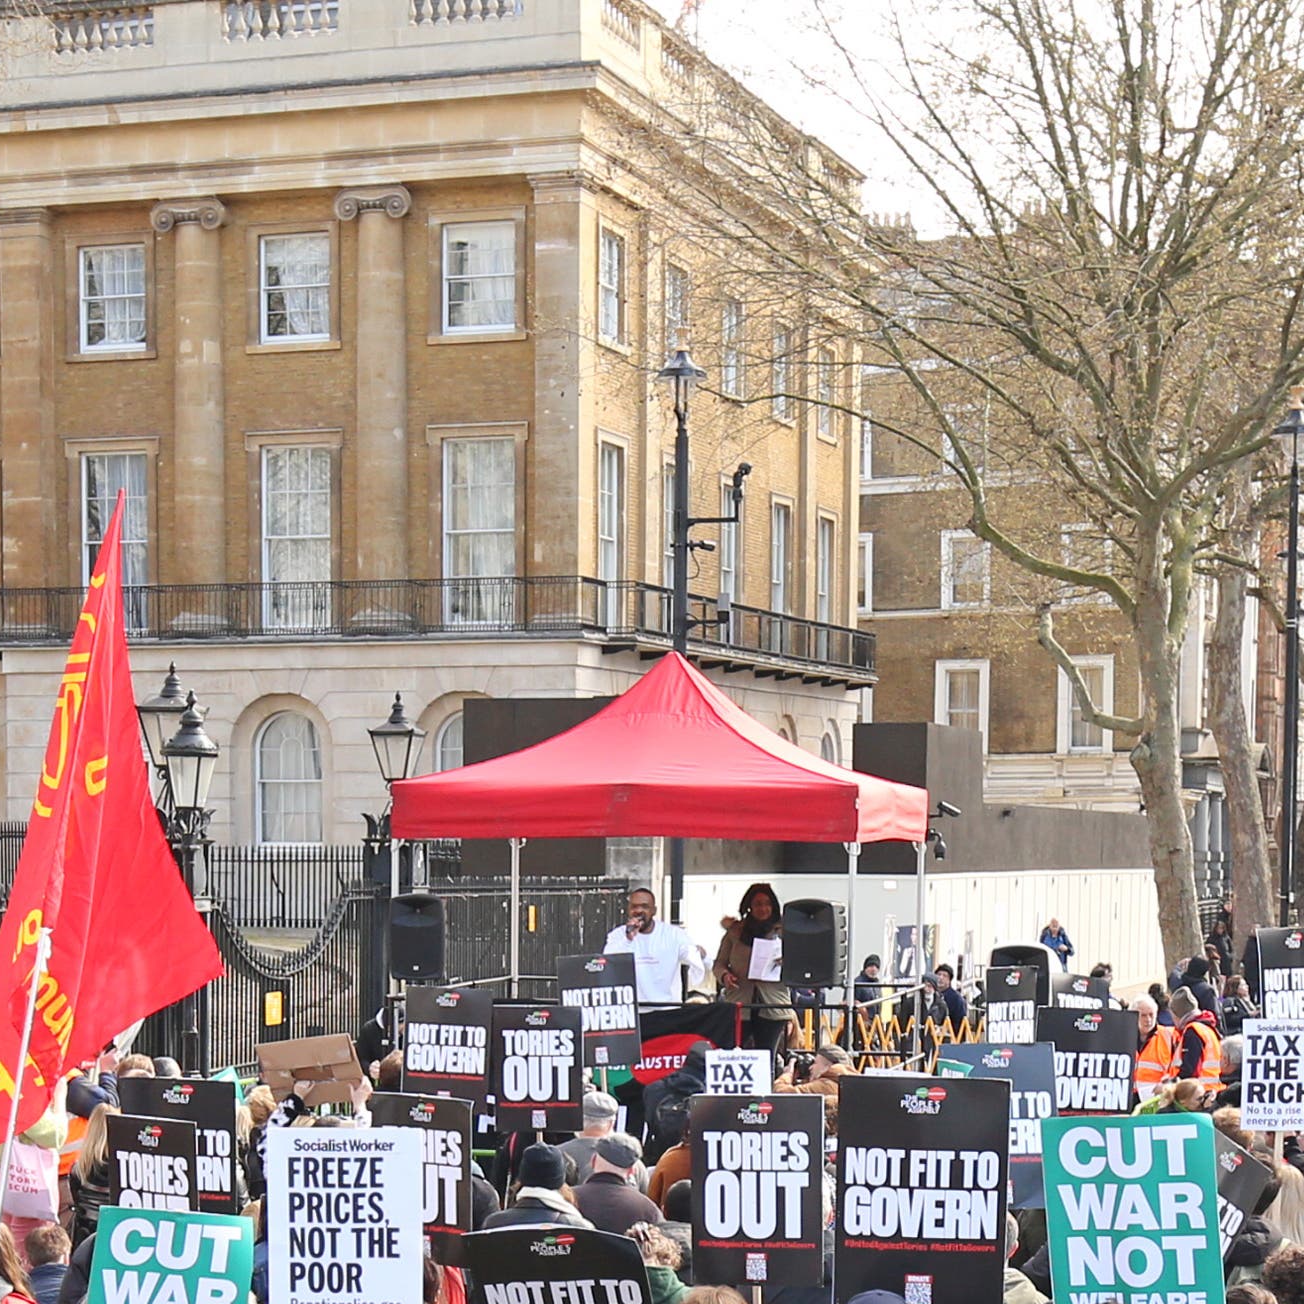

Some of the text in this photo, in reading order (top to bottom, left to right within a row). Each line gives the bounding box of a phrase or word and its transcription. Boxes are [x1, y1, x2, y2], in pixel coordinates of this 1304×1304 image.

[1264, 968, 1289, 991] NOT
[562, 985, 633, 1006] NOT FIT TO
[989, 1000, 1034, 1021] NOT FIT TO
[407, 1023, 486, 1047] NOT FIT TO
[502, 1029, 574, 1056] TORIES
[988, 1019, 1034, 1043] GOVERN
[1247, 1035, 1301, 1056] TAX
[407, 1043, 486, 1075] GOVERN
[711, 1064, 753, 1081] TAX
[1055, 1052, 1131, 1079] OT FIT TO
[1247, 1058, 1299, 1080] THE
[503, 1056, 574, 1102] OUT
[1057, 1077, 1129, 1110] OVERN
[1026, 1091, 1052, 1118] TO
[1247, 1106, 1260, 1114] No
[1285, 1106, 1302, 1114] rise
[1246, 1117, 1278, 1126] energy
[204, 1129, 230, 1156] TO
[703, 1131, 809, 1171] TORIES
[1059, 1125, 1198, 1179] CUT
[116, 1151, 189, 1196] TORIES
[288, 1157, 384, 1189] FREEZE
[846, 1147, 999, 1189] NOT FIT TO
[9, 1184, 38, 1194] SCUM
[289, 1192, 389, 1228] PRICES,
[705, 1170, 809, 1239] OUT
[844, 1185, 998, 1240] GOVERN
[1057, 1182, 1206, 1231] WAR
[110, 1218, 242, 1273] CUT
[289, 1228, 400, 1258] NOT THE
[1067, 1235, 1207, 1288] NOT
[290, 1262, 363, 1293] POOR
